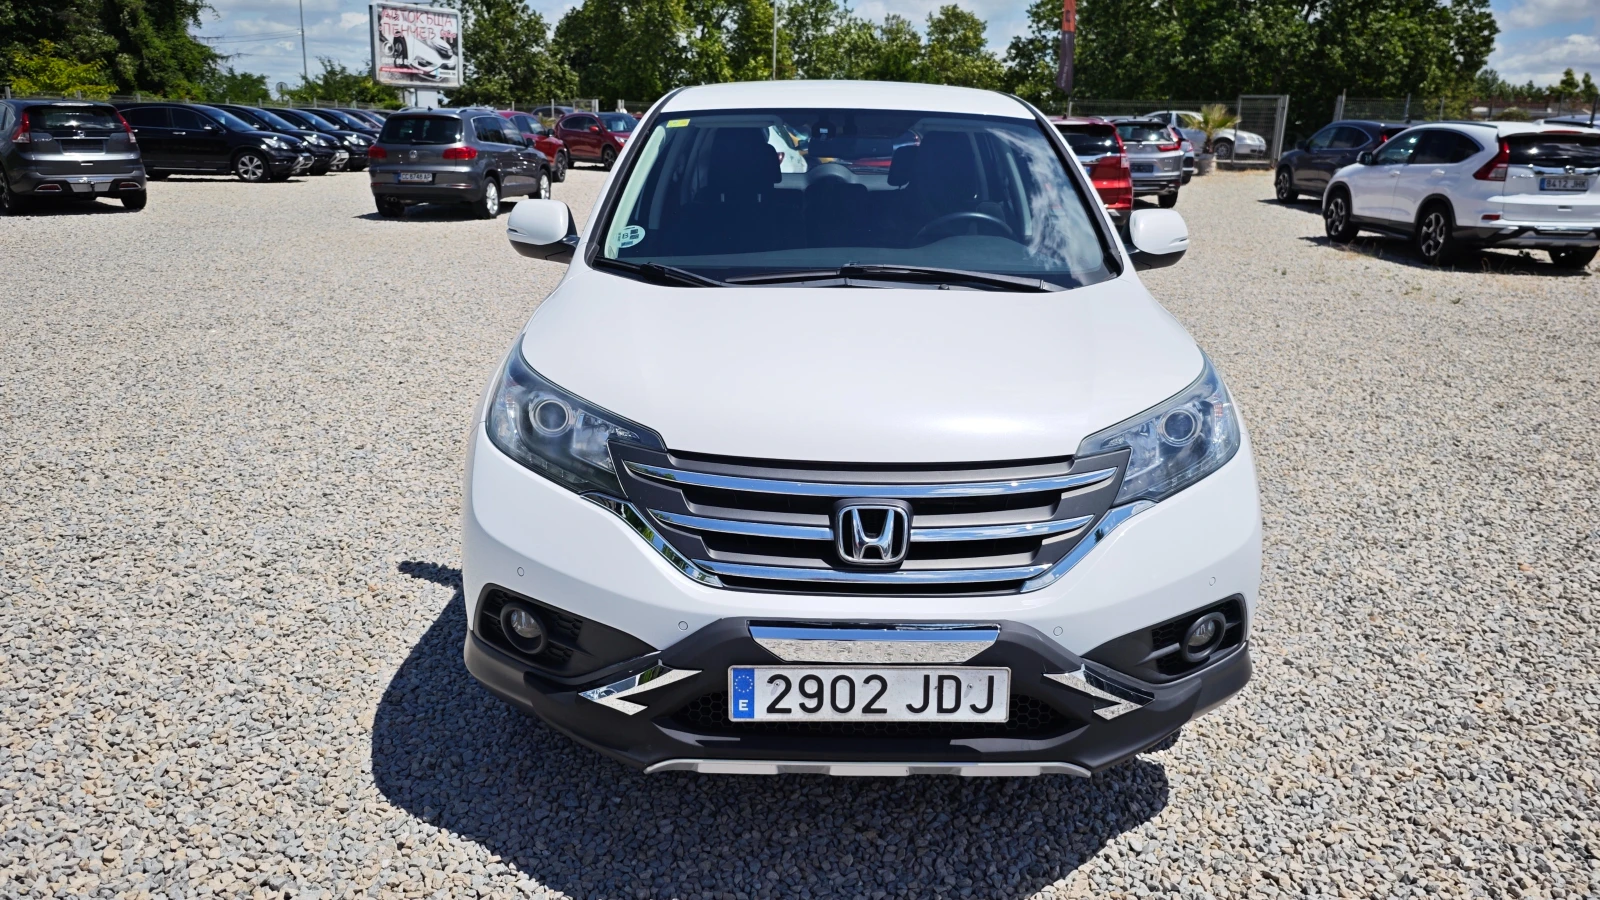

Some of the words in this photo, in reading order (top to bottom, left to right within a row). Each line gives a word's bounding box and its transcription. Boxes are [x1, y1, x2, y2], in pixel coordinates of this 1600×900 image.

[383, 22, 436, 41] ПЕНЧЕВ
[1546, 179, 1568, 188] 8412
[766, 674, 888, 714] 2902
[905, 674, 995, 714] JDJ
[738, 699, 749, 711] E
